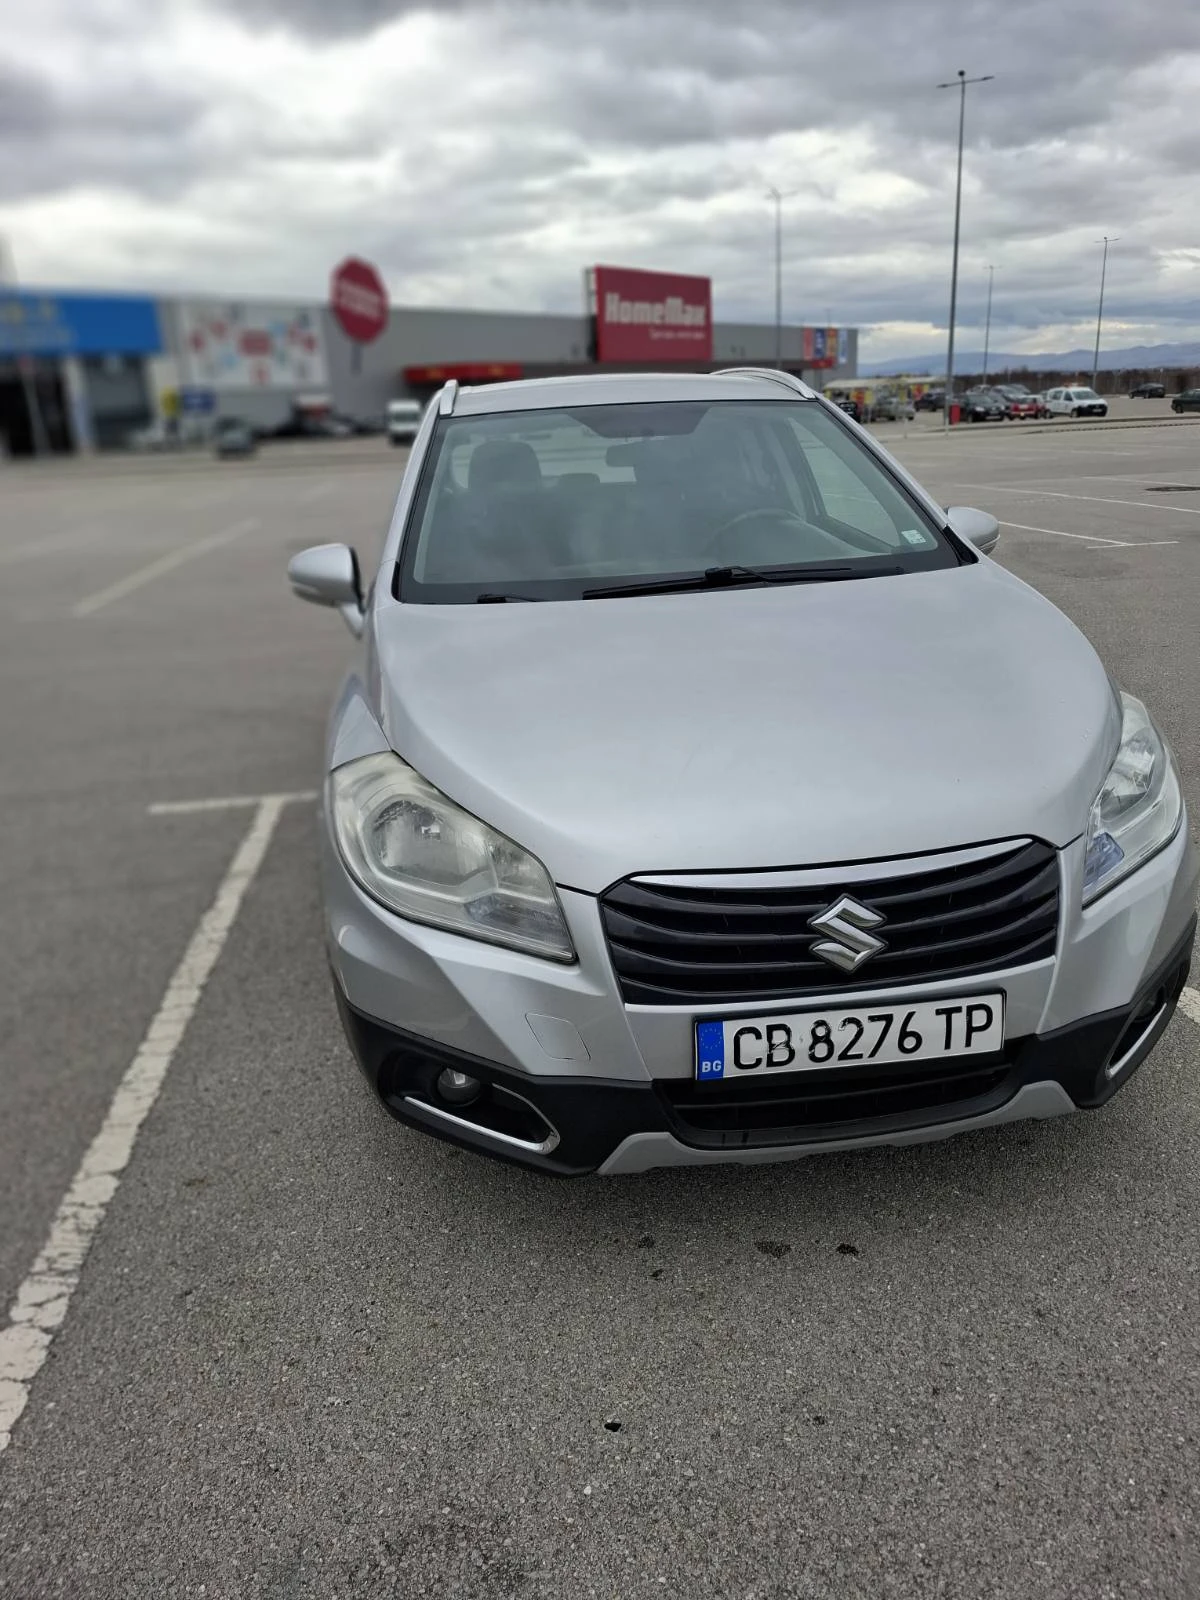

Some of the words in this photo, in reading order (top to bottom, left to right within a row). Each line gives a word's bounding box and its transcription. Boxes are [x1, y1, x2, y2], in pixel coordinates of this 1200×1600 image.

[733, 1023, 796, 1070] CB
[808, 1011, 923, 1063] 8276
[935, 1003, 994, 1050] TP
[702, 1061, 722, 1073] BG
